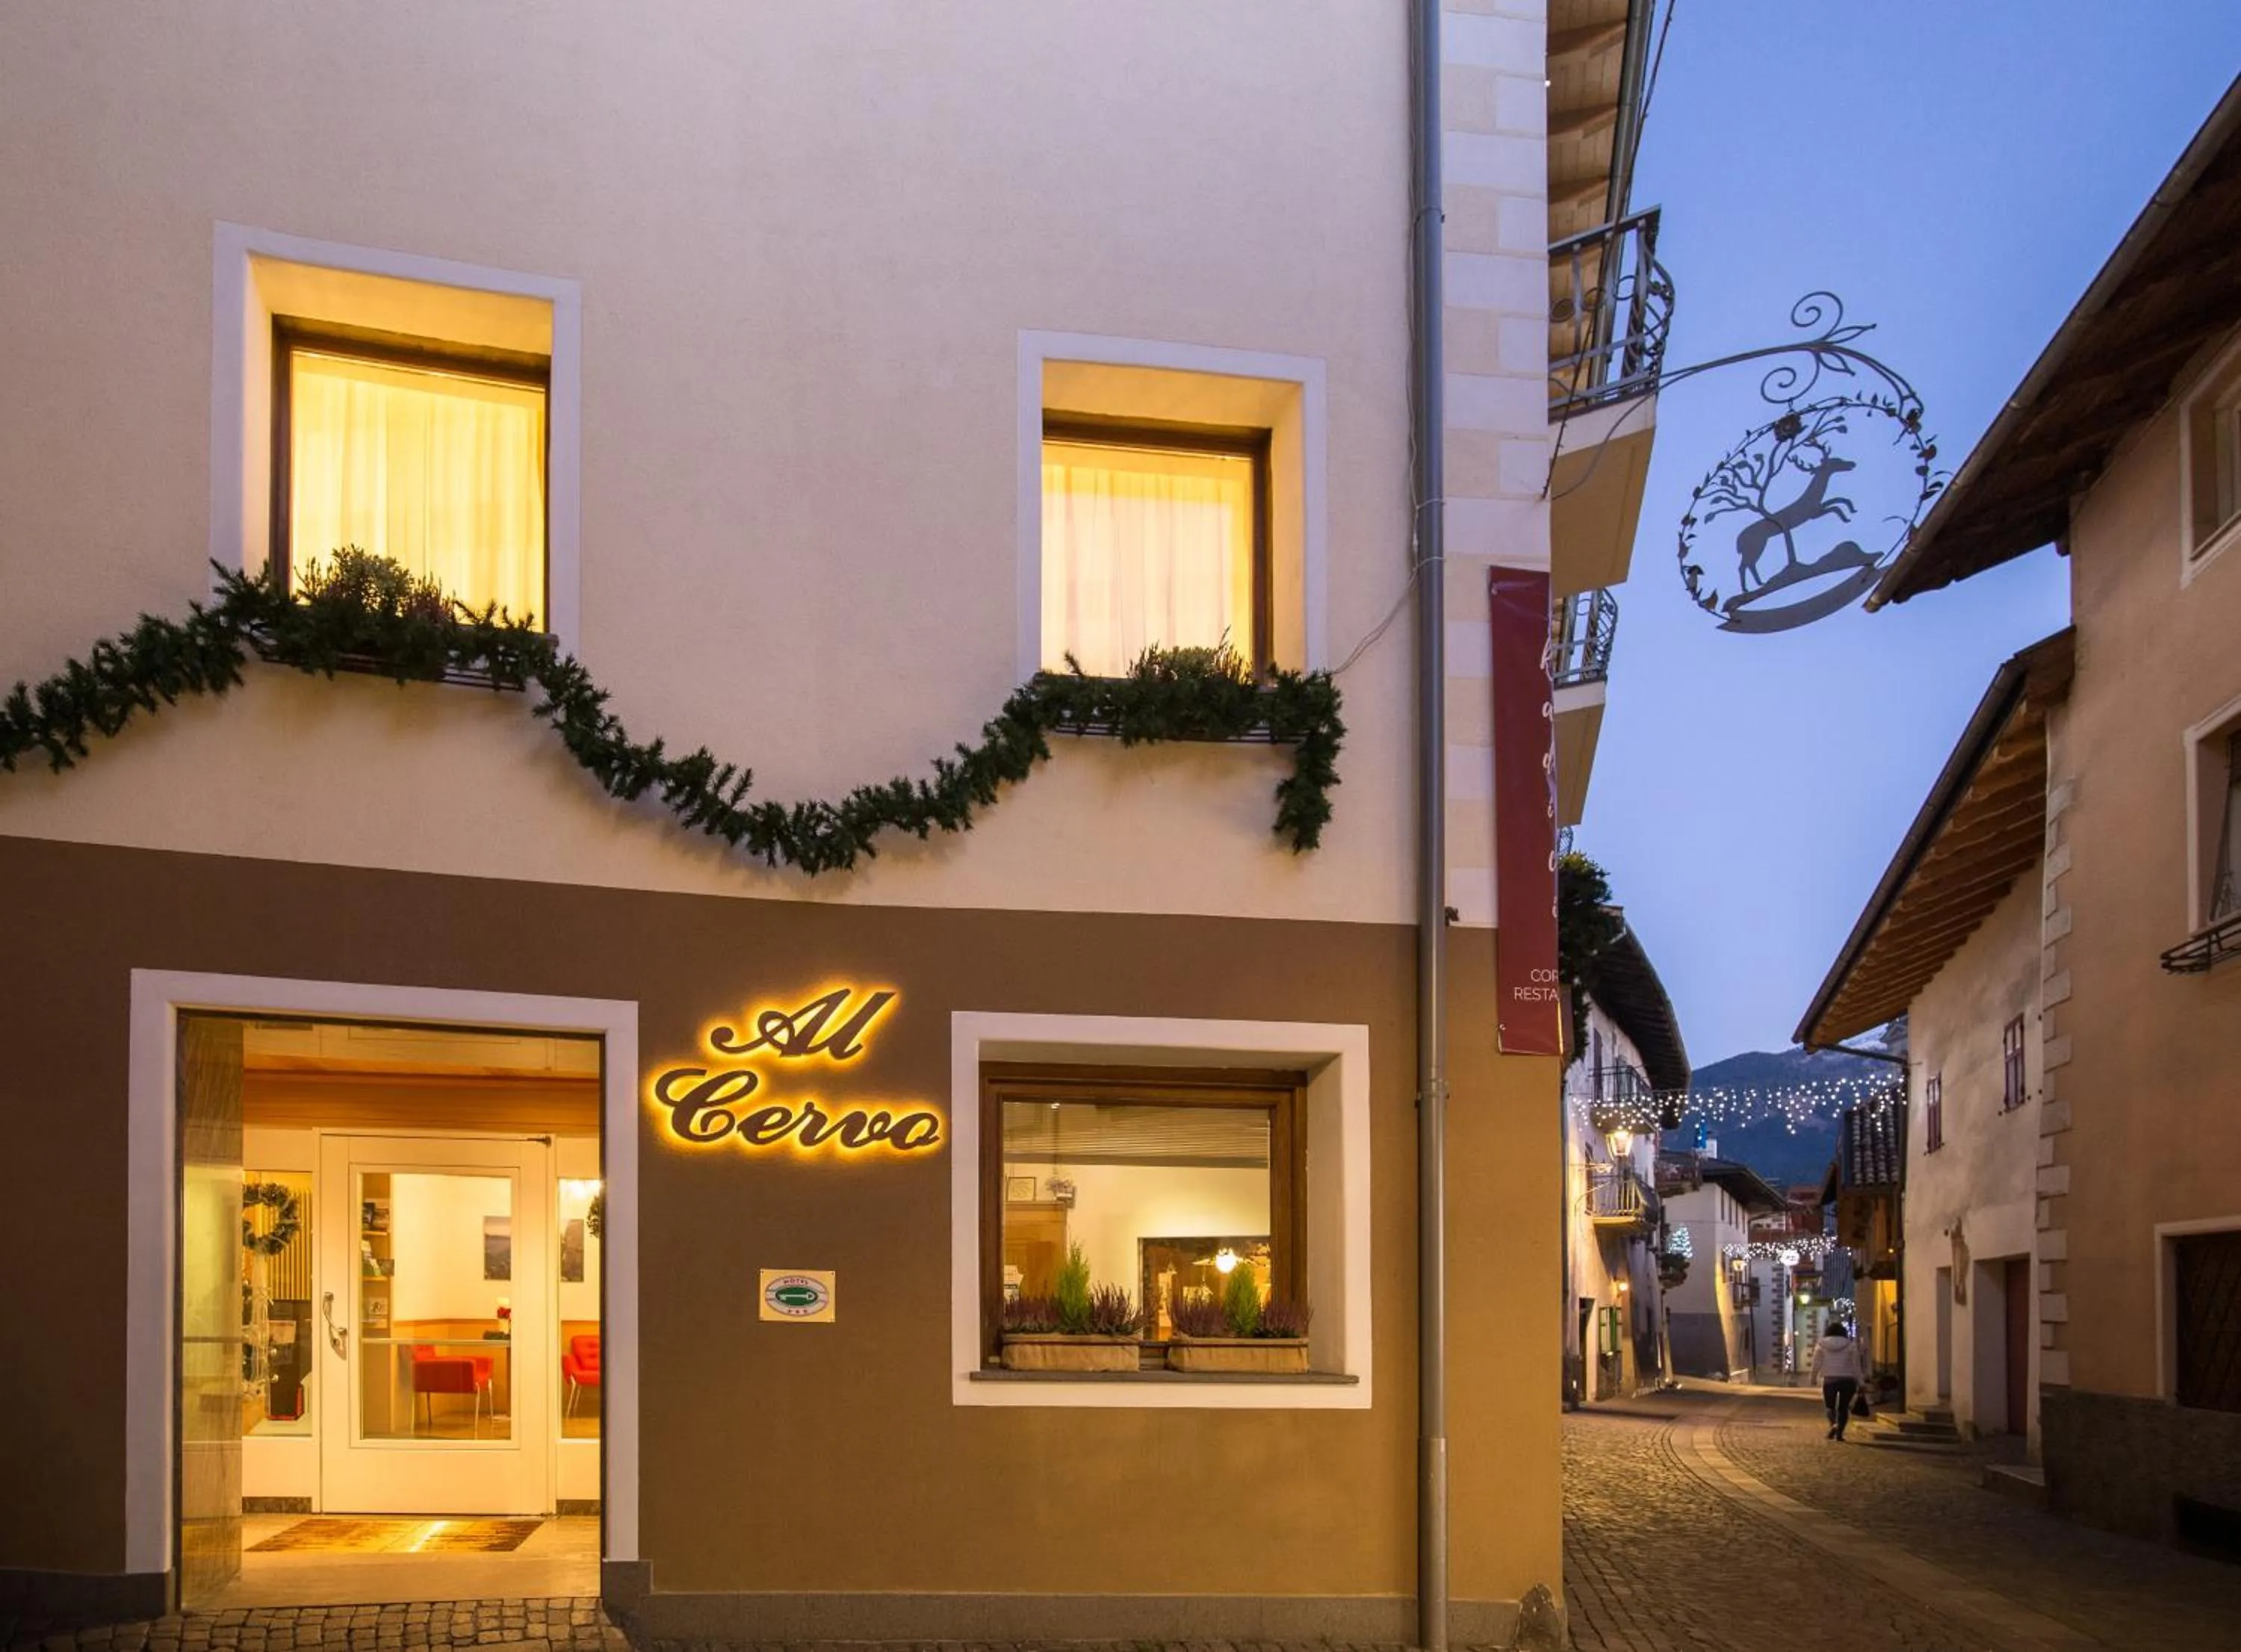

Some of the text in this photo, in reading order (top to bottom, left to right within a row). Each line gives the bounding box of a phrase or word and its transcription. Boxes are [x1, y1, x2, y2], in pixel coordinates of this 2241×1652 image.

[710, 988, 896, 1060] Al
[1514, 987, 1560, 1001] RESTA
[655, 1068, 940, 1150] Cervo
